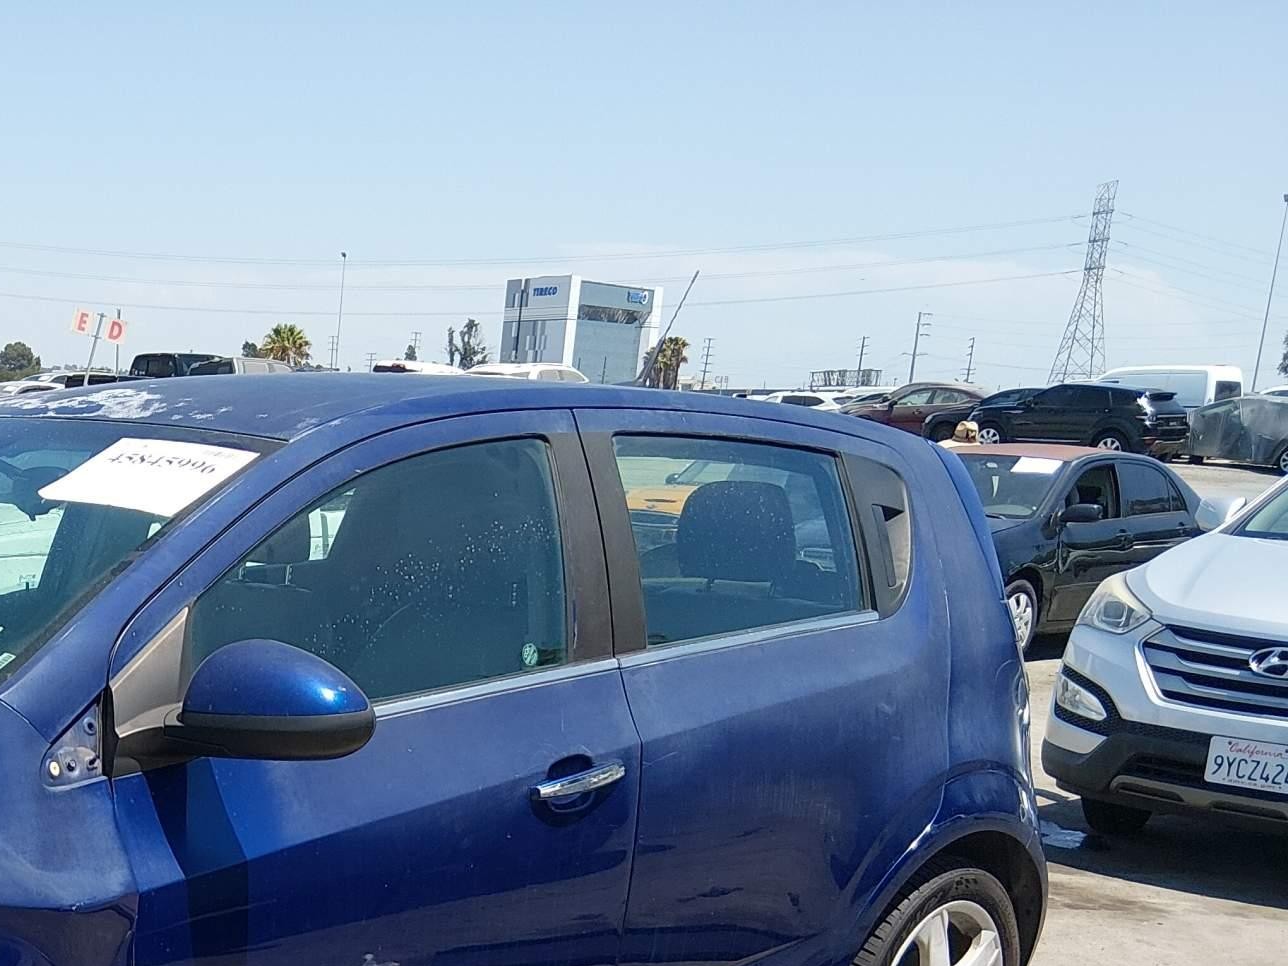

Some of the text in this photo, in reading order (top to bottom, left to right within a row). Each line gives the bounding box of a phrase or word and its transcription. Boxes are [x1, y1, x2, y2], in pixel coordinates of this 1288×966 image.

[77, 312, 89, 332] E
[108, 320, 123, 341] D
[1228, 741, 1283, 758] California
